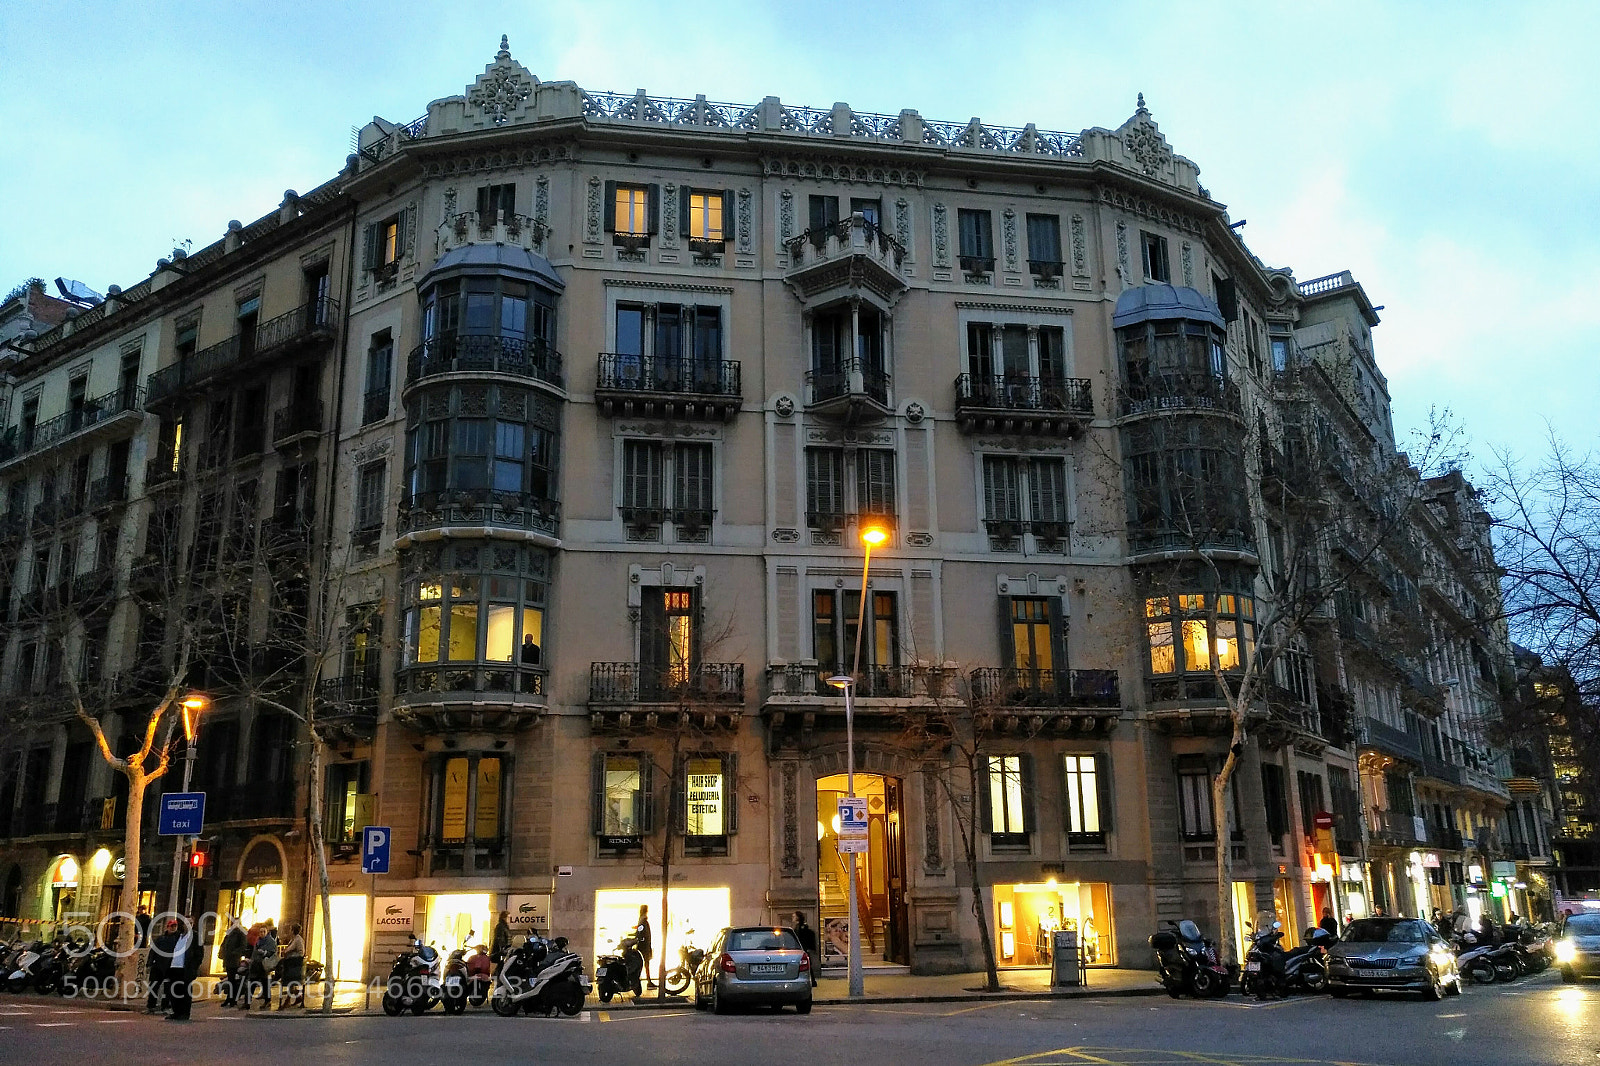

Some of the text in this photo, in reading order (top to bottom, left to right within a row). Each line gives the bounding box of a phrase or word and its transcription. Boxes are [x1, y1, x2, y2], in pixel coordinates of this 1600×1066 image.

[691, 775, 718, 787] HAIR SHOP
[689, 791, 720, 801] PELUQUERIA
[691, 804, 717, 814] ESTETICA
[841, 808, 850, 821] P
[172, 819, 190, 828] taxi
[367, 830, 386, 855] P
[376, 917, 411, 925] LACOSTE
[509, 915, 546, 924] LACOSTE
